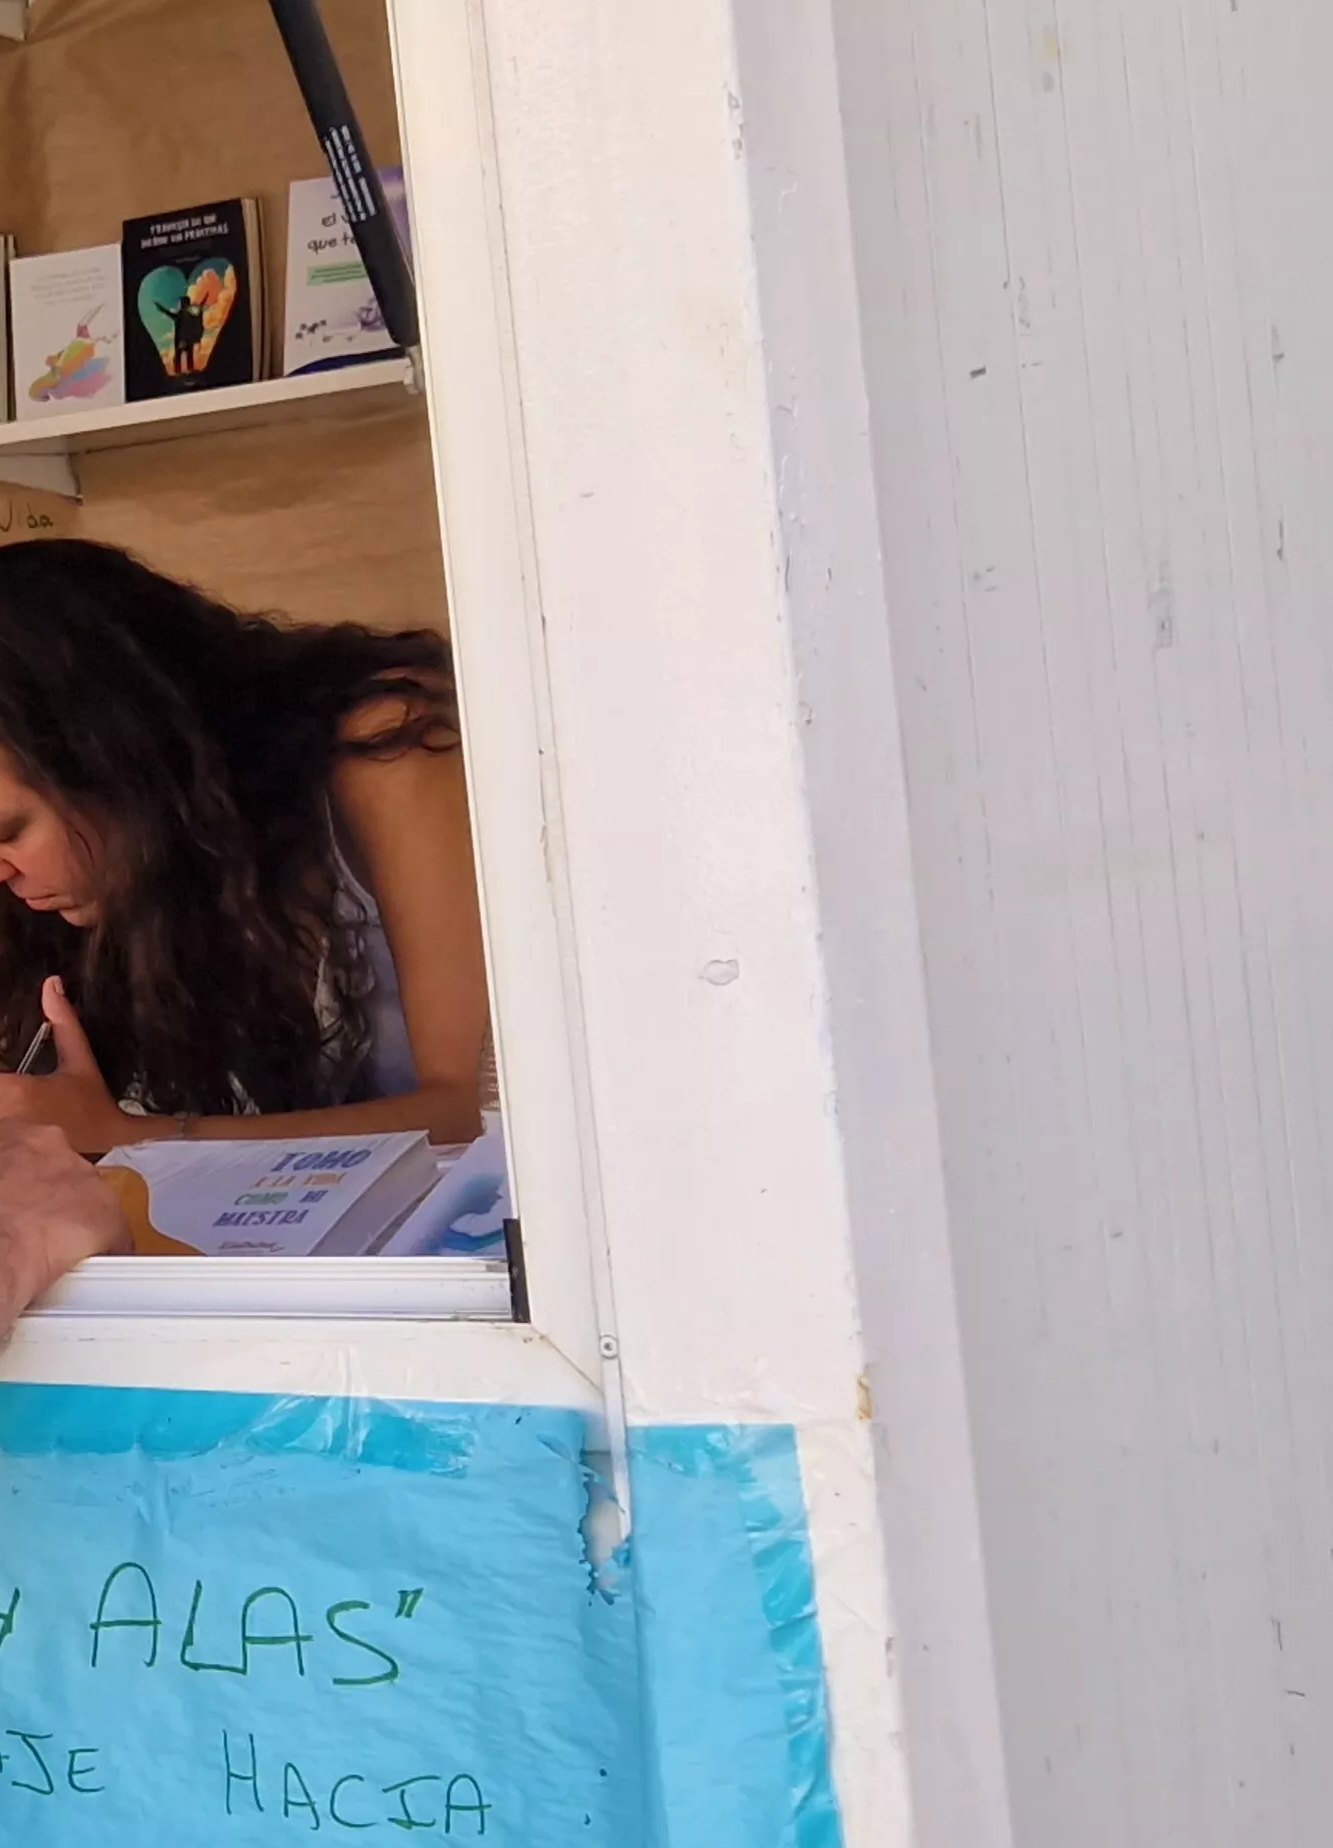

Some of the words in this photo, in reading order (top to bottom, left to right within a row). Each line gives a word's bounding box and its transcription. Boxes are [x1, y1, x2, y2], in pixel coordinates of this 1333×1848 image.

[307, 236, 338, 255] que
[271, 1149, 372, 1173] TOMO
[222, 1728, 493, 1835] HACIA
